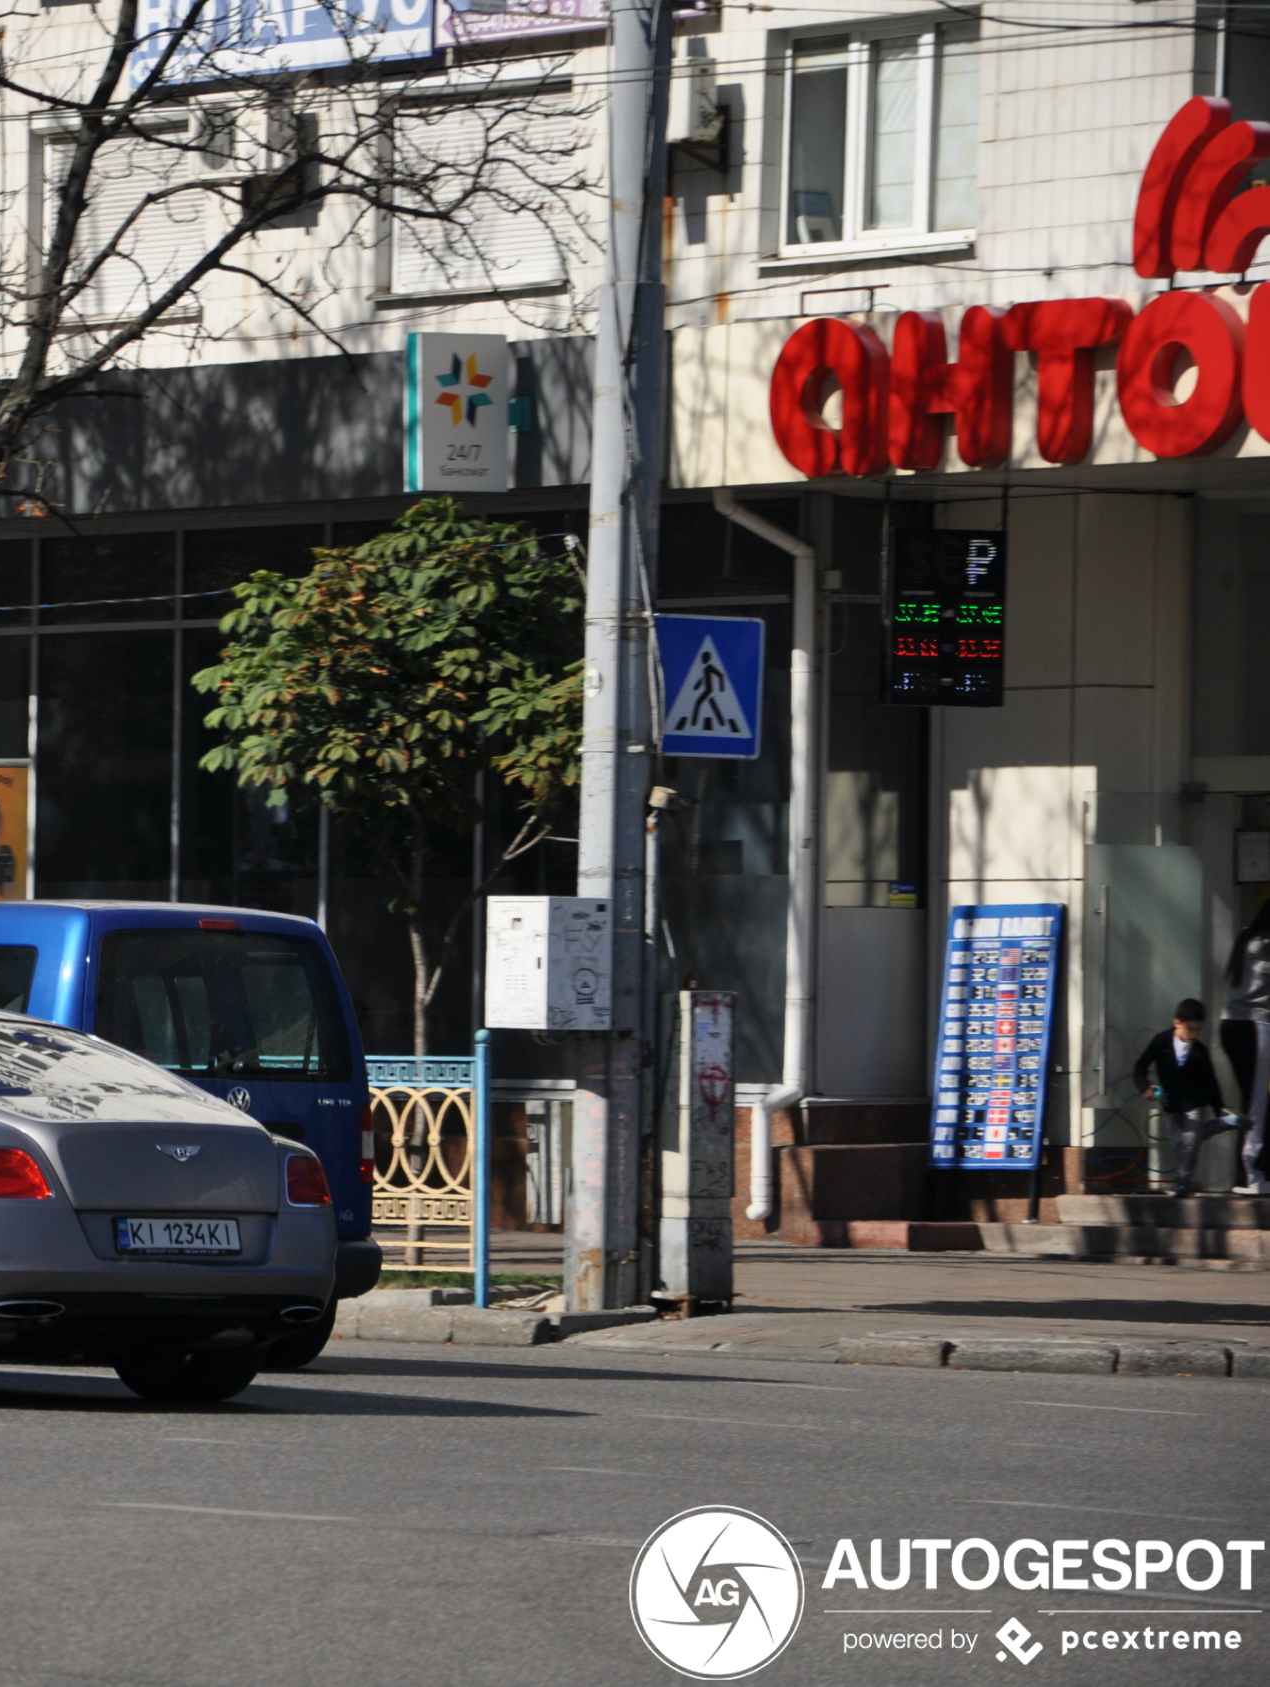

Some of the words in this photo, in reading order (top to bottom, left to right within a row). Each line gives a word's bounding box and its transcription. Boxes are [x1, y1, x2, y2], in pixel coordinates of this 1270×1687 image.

[770, 281, 1270, 477] АНТО
[447, 444, 482, 461] 24/7
[318, 1099, 335, 1107] LIFE
[130, 1223, 155, 1245] KI
[163, 1223, 206, 1245] 1234
[208, 1223, 231, 1246] KI
